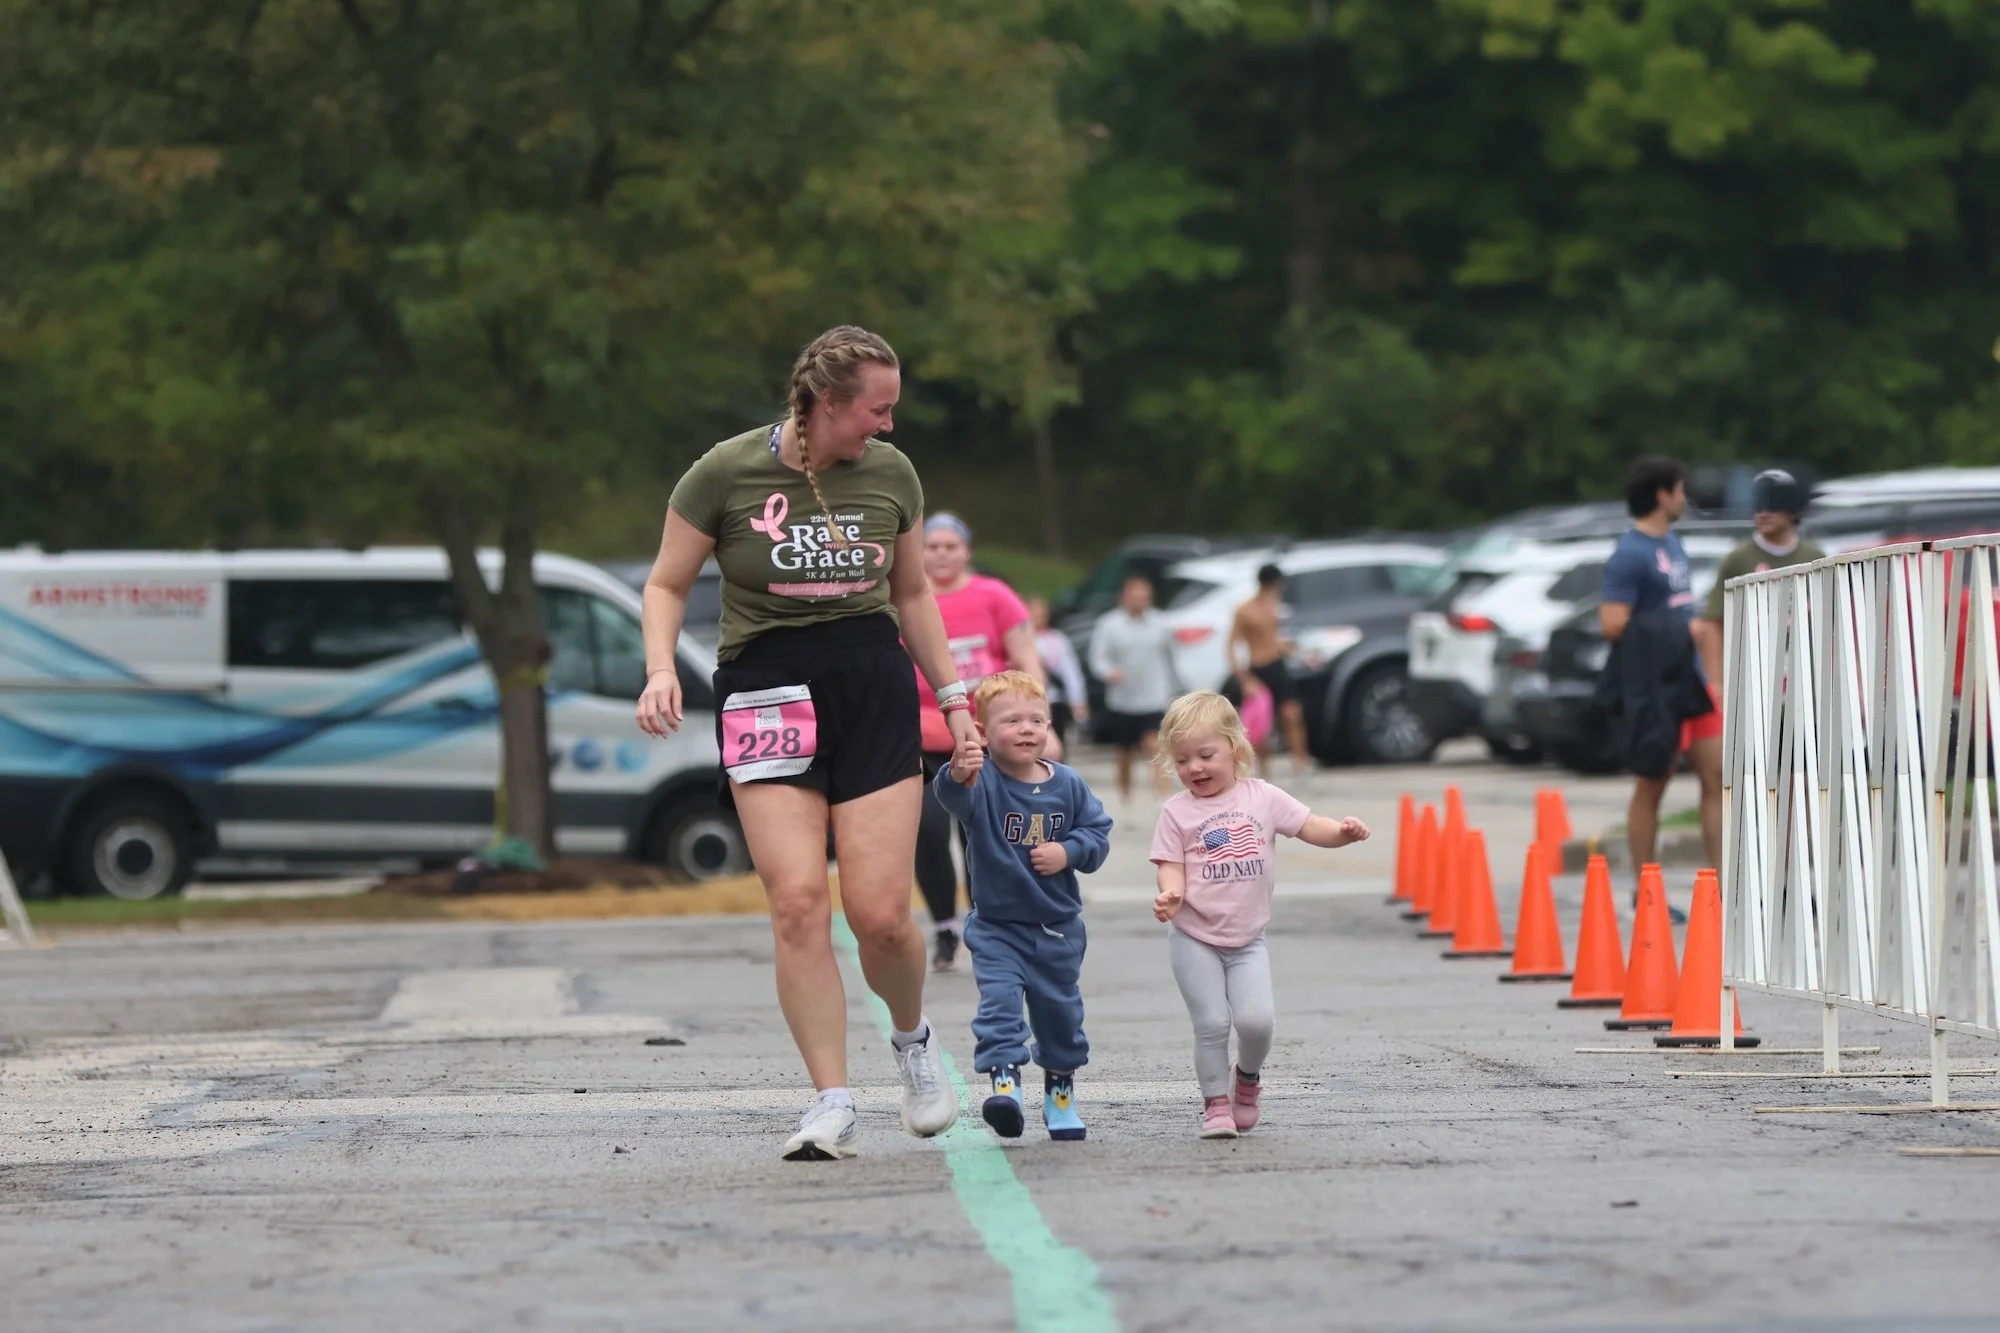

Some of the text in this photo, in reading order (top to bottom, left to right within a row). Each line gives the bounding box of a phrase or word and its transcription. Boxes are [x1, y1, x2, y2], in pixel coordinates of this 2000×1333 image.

[834, 513, 864, 522] Annual
[771, 542, 865, 570] Grace
[805, 568, 865, 579] 5K & Fun Walk
[28, 583, 208, 607] ARMSTRONG
[738, 727, 801, 762] 228
[1003, 812, 1065, 845] GAP
[1246, 815, 1264, 832] YEARS
[1257, 838, 1265, 846] 26
[1202, 859, 1265, 880] OLD NAVY
